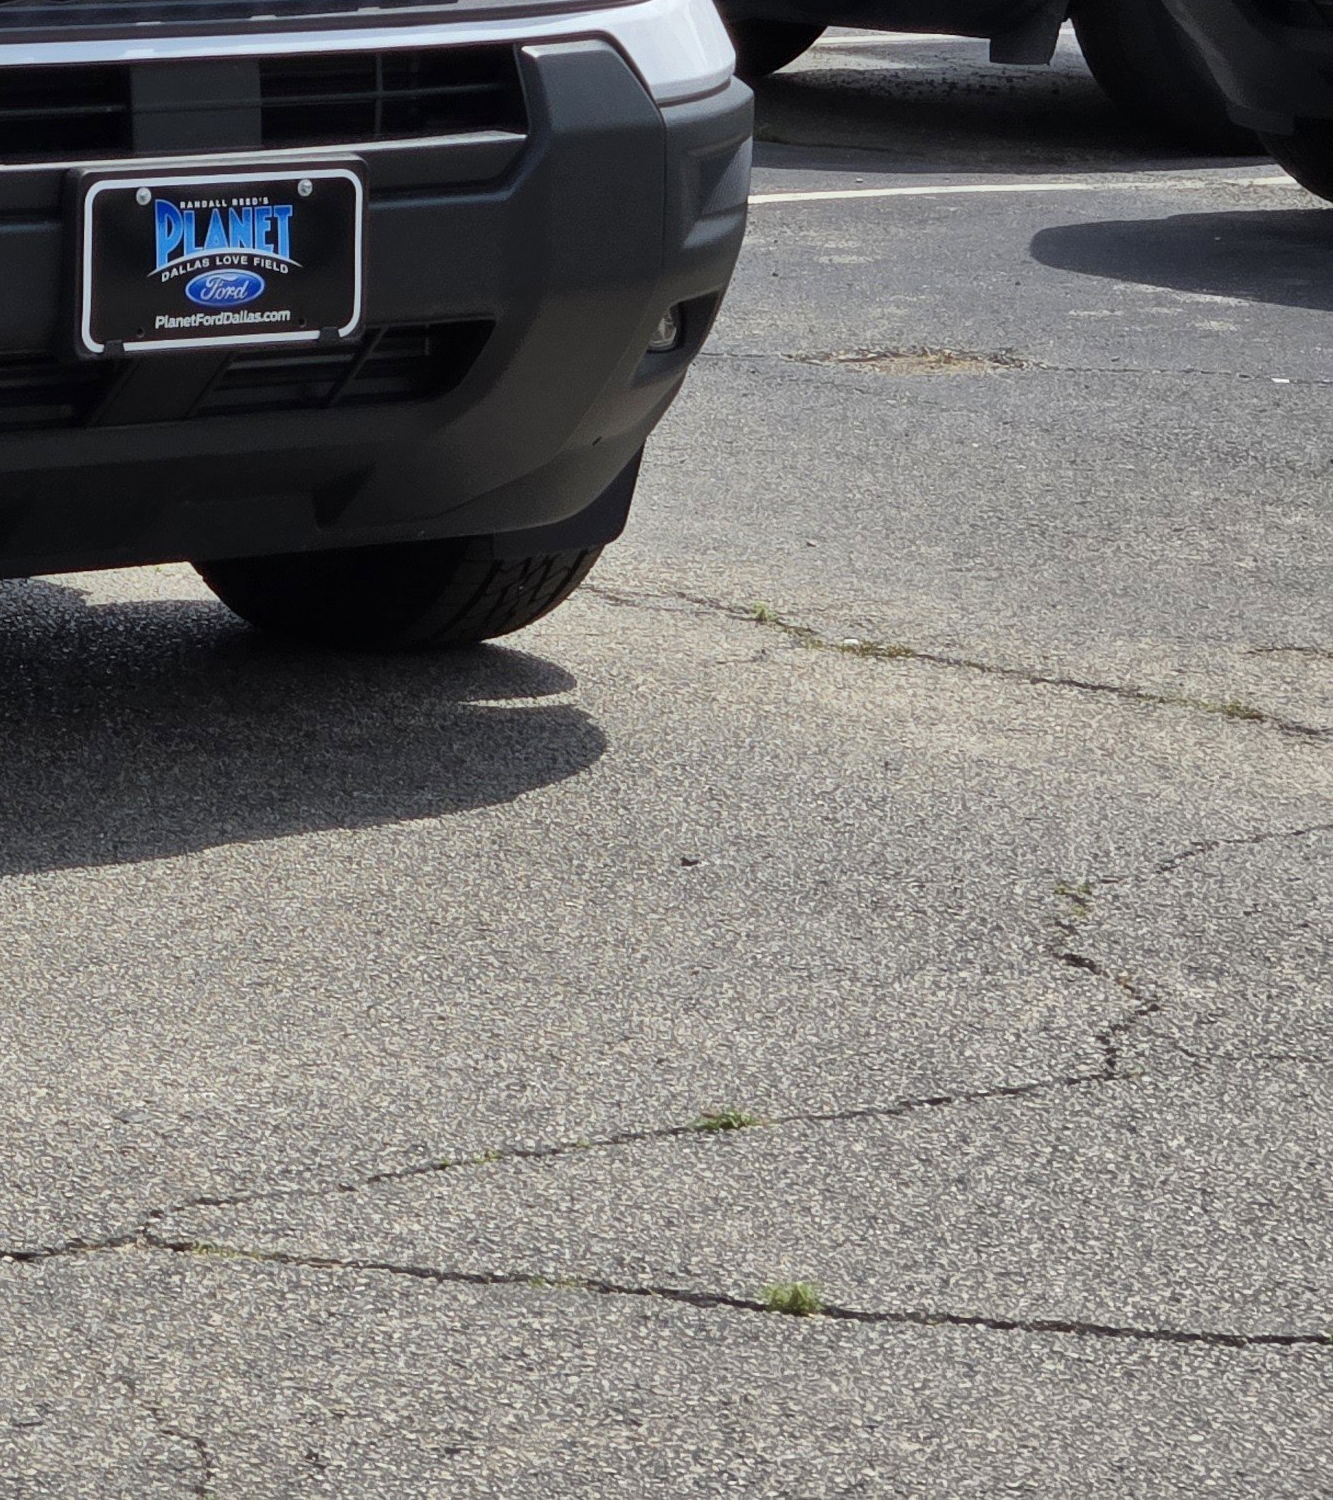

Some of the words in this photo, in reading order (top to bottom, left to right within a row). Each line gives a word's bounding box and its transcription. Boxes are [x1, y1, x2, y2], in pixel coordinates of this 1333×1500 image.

[180, 199, 227, 209] RANDALL
[155, 199, 293, 271] PLANET
[162, 258, 210, 282] DALLAS
[215, 255, 249, 266] LOVE
[253, 257, 288, 273] FIELD
[200, 276, 249, 300] Ford
[155, 309, 291, 329] PlanetFordDallas.com
